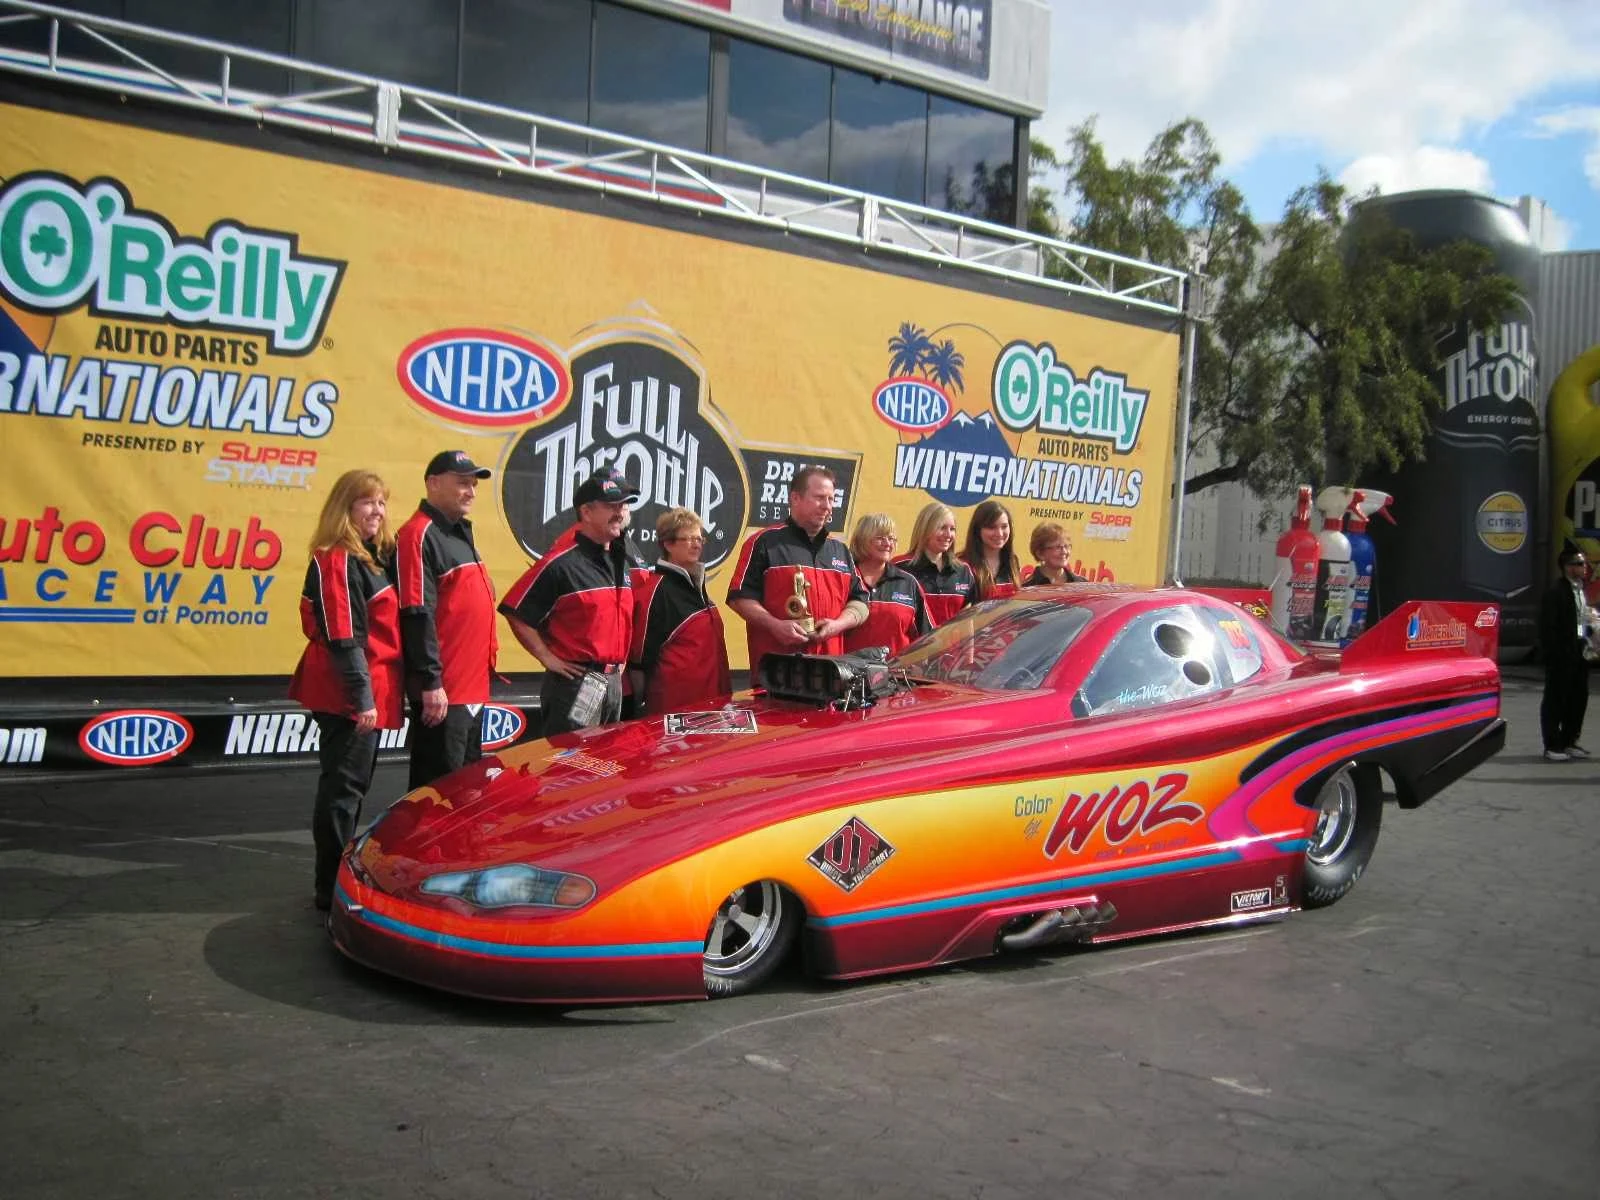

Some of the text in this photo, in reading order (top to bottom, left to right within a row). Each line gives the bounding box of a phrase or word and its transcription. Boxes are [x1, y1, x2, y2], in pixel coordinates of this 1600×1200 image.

[0, 188, 327, 341] O'Reilly
[95, 325, 259, 365] AUTO PARTS
[424, 344, 545, 411] NHRA
[884, 386, 943, 423] NHRA
[999, 351, 1141, 446] O'Reilly
[1467, 414, 1508, 424] ENERGY
[82, 433, 204, 454] PRESENTED BY
[220, 441, 318, 467] SUPER
[1038, 437, 1108, 461] AUTO PARTS
[203, 458, 317, 487] START
[893, 443, 1143, 508] WINTERNATIONALS
[1030, 508, 1084, 520] PRESENTED BY
[1090, 512, 1132, 527] SUPER
[1487, 518, 1522, 528] CITRUS
[129, 511, 282, 571] Club
[143, 605, 268, 625] at Pomona
[96, 717, 180, 755] NHRA
[1014, 795, 1053, 817] Color
[1043, 772, 1206, 860] WOZ
[1235, 891, 1268, 908] VICTORY
